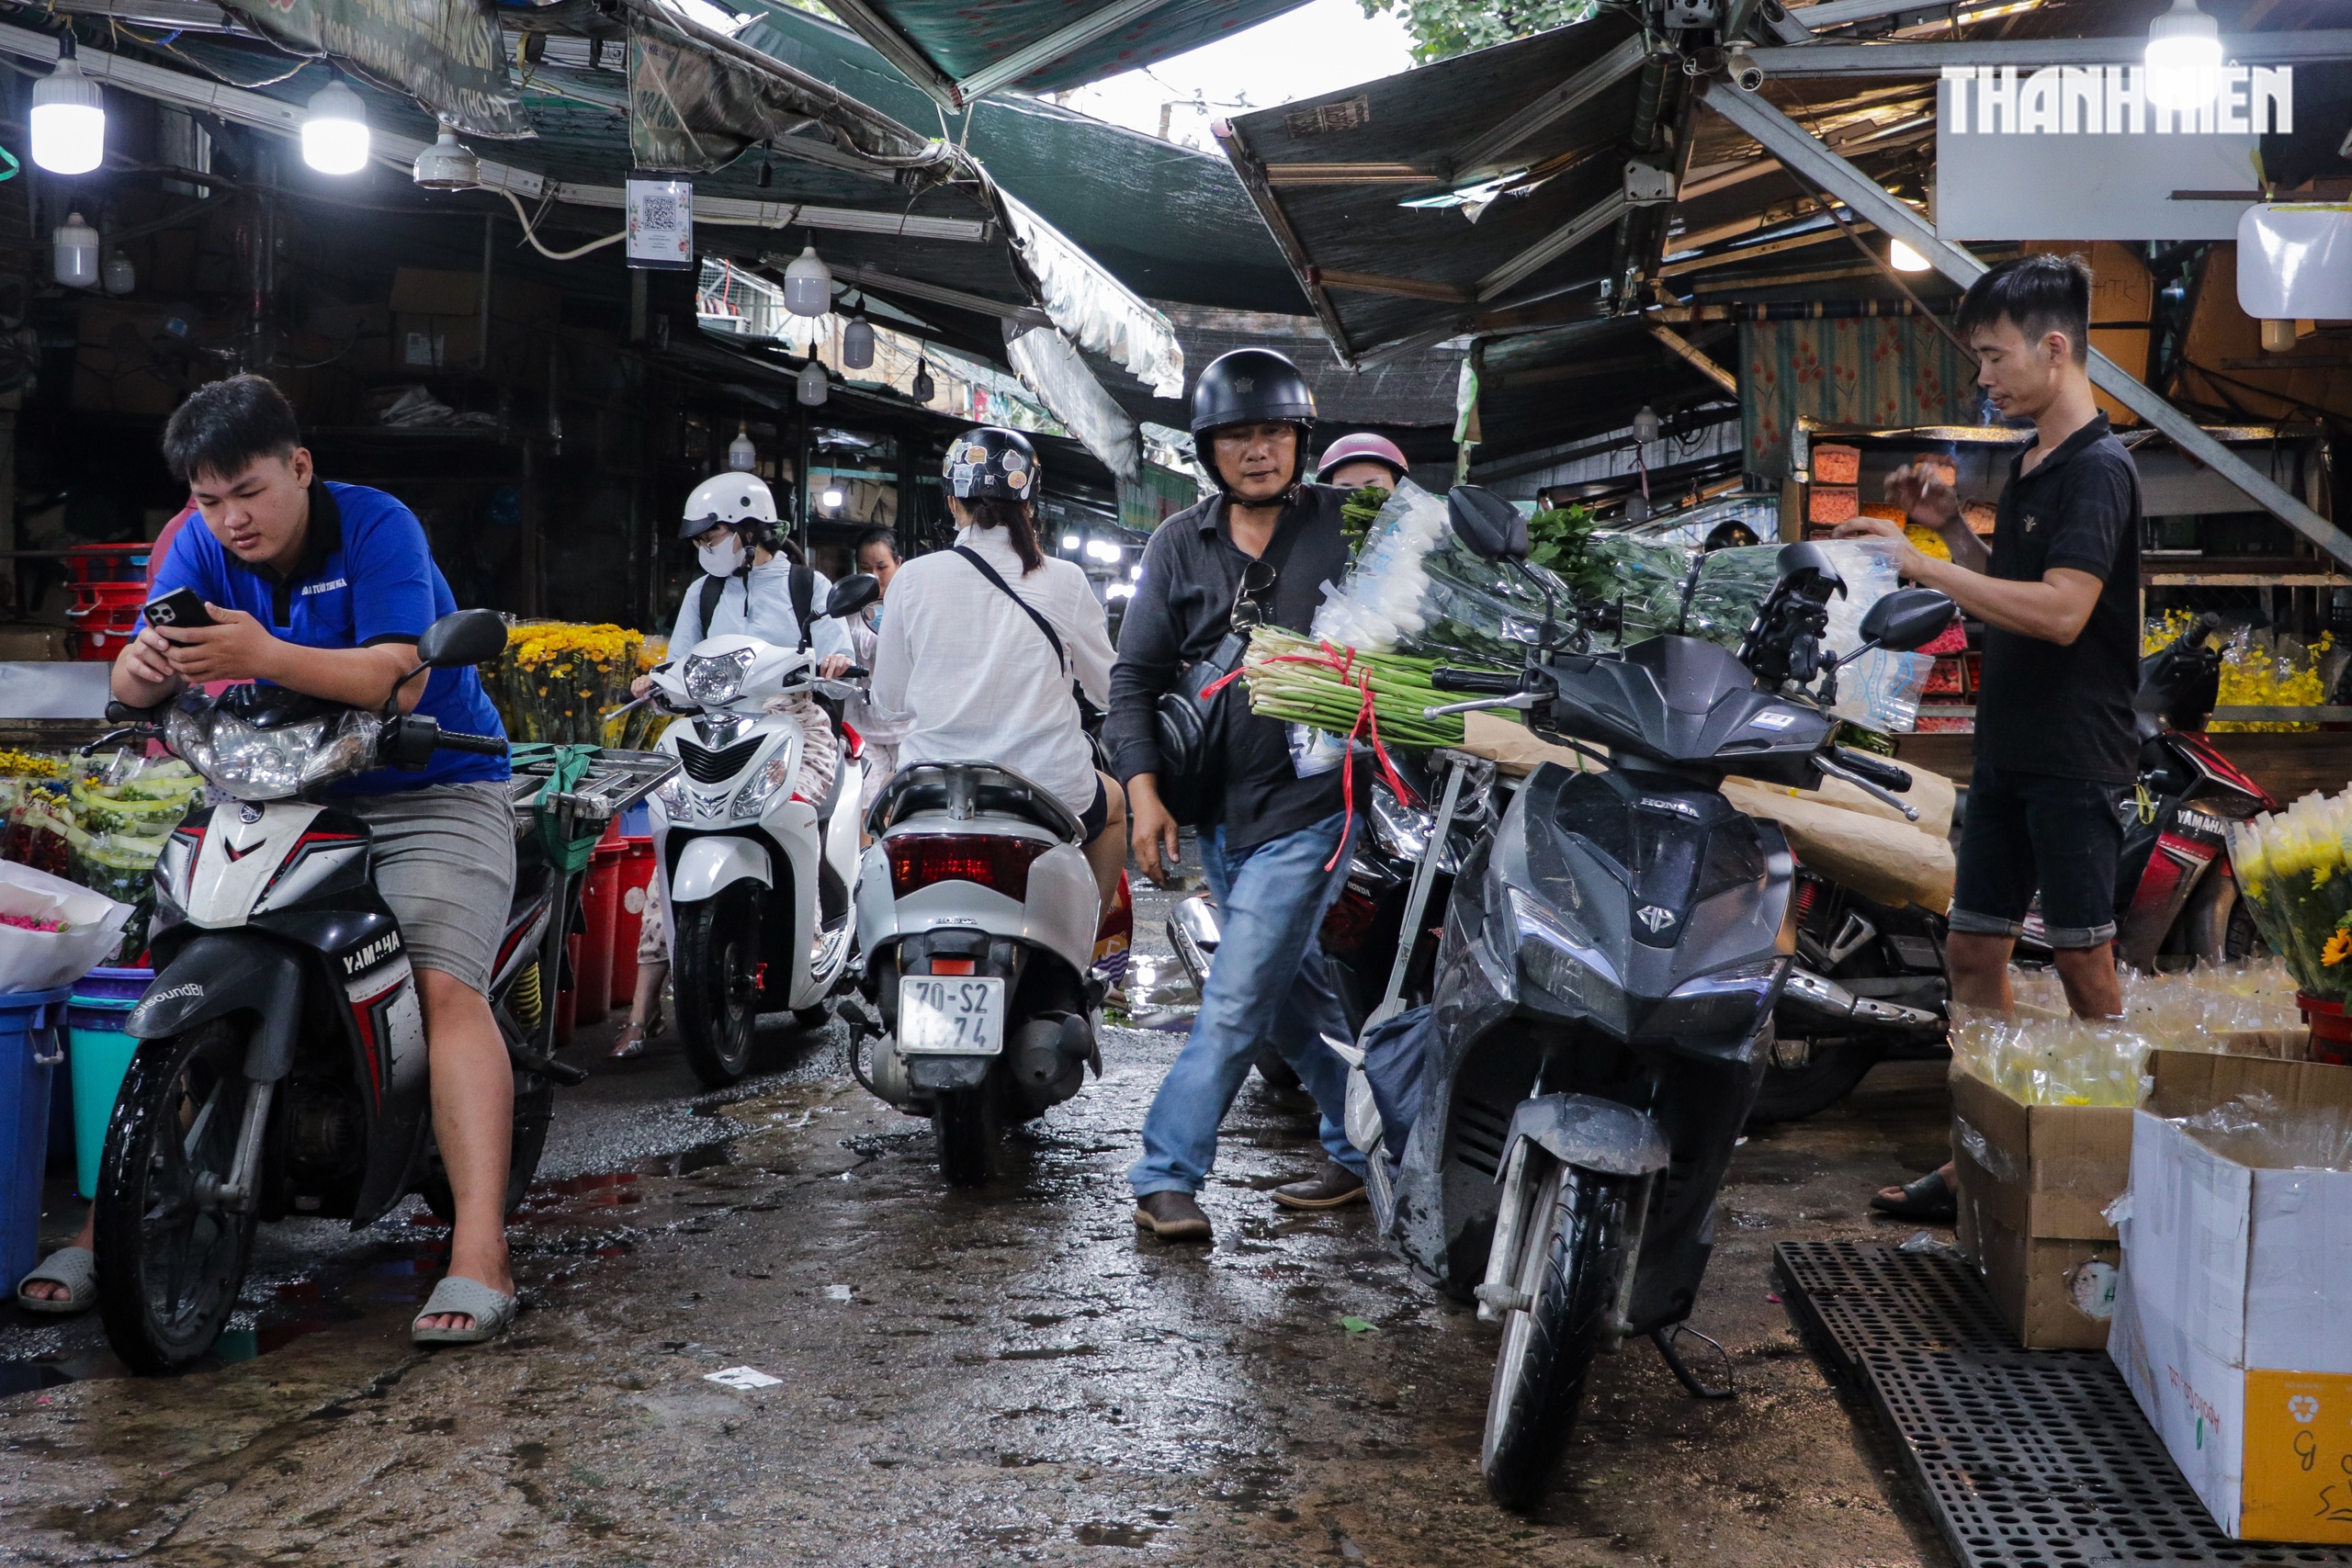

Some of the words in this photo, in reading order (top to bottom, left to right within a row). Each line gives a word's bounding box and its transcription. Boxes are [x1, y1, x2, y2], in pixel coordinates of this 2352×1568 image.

[1640, 797, 1700, 818] HONDA
[1347, 881, 1372, 897] HONDA
[343, 930, 401, 975] YAMAHA
[915, 982, 989, 1014] 70-S2
